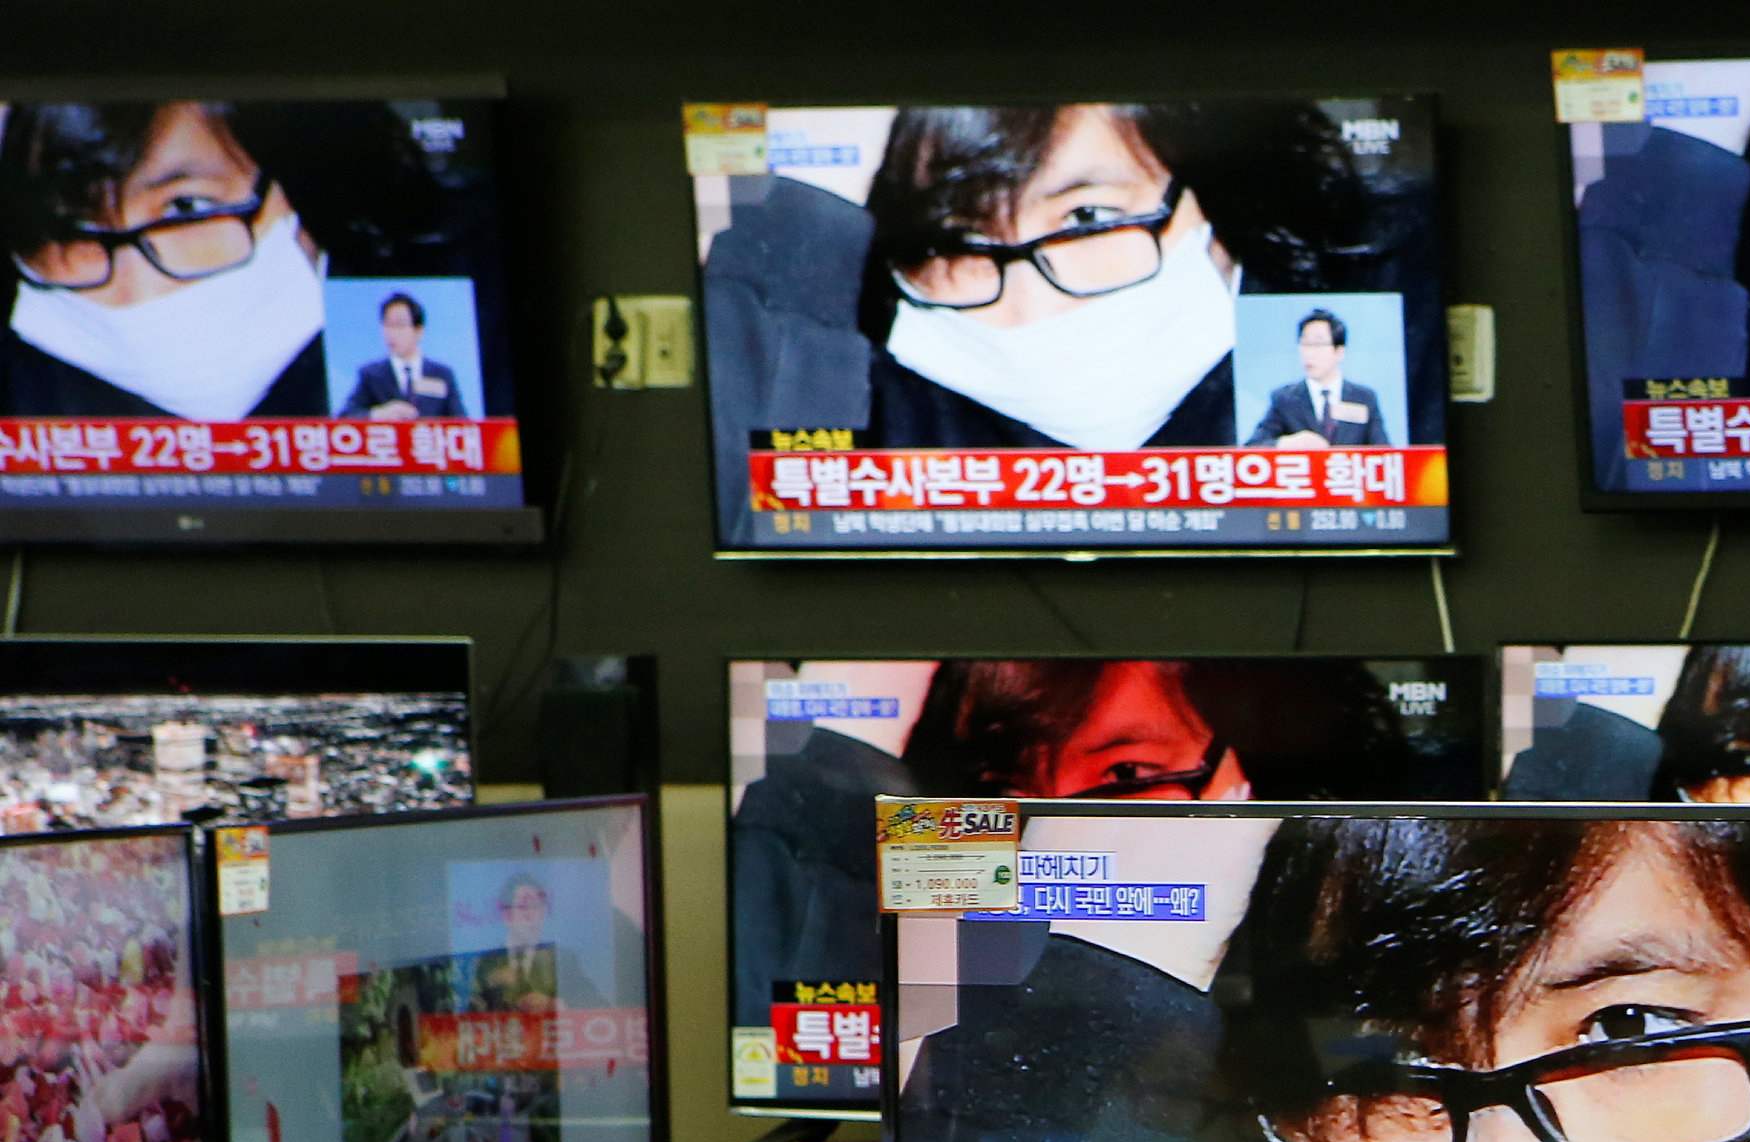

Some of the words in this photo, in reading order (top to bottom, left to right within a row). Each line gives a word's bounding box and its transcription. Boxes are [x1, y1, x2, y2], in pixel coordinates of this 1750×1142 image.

[410, 423, 484, 470] 확대
[771, 455, 1006, 507] 특별수사본부
[1324, 452, 1407, 502] 확대
[1389, 681, 1447, 702] MBN
[1035, 886, 1072, 916] 다시
[1074, 886, 1113, 915] 국민
[793, 1010, 881, 1060] 특별
